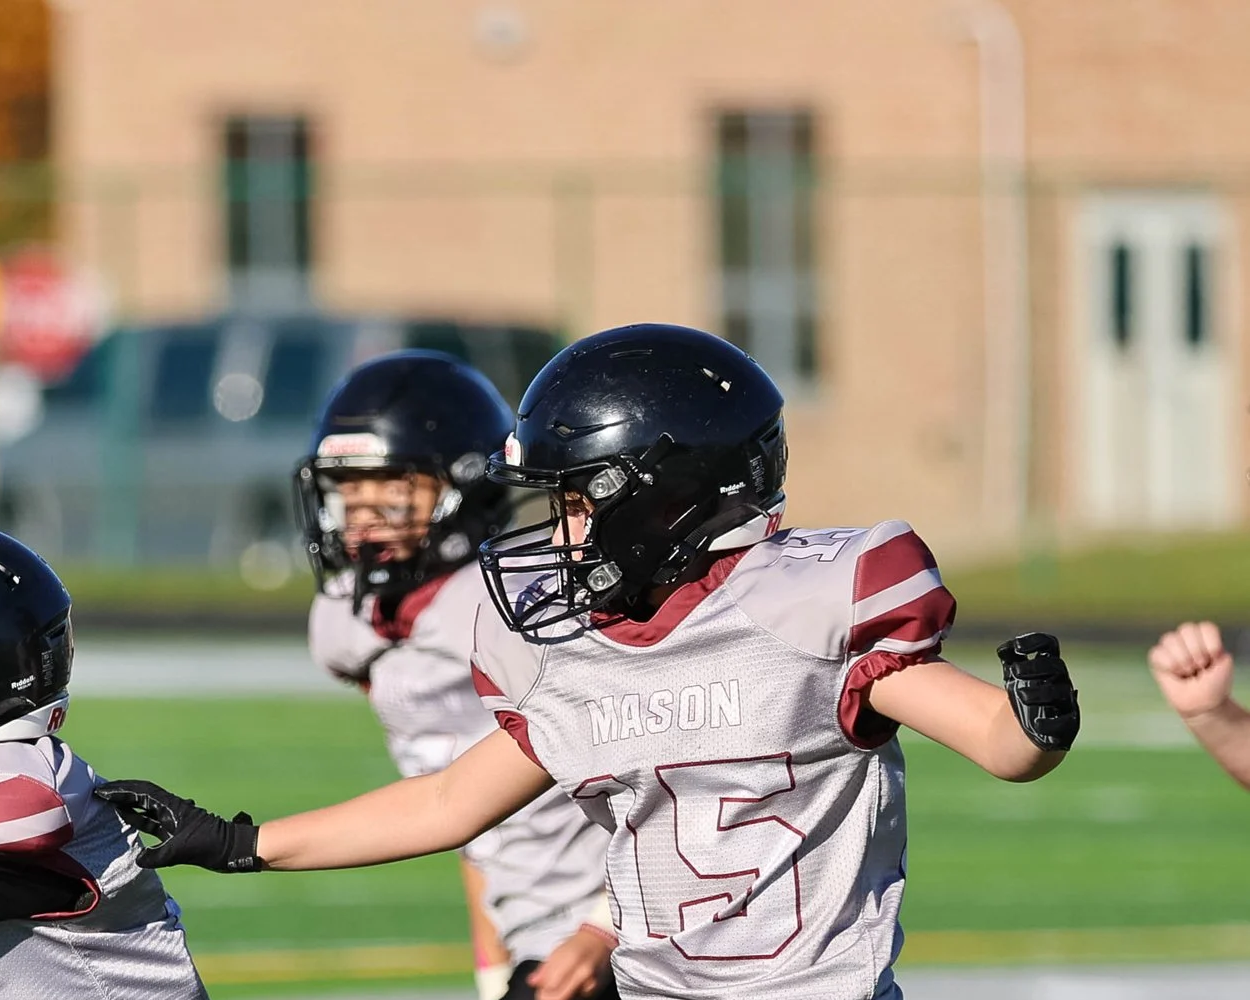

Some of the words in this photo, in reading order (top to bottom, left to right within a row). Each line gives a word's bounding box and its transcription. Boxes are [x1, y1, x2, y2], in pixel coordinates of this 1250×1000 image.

[10, 675, 36, 689] Riddell
[584, 679, 742, 746] MASON
[572, 751, 807, 961] 15
